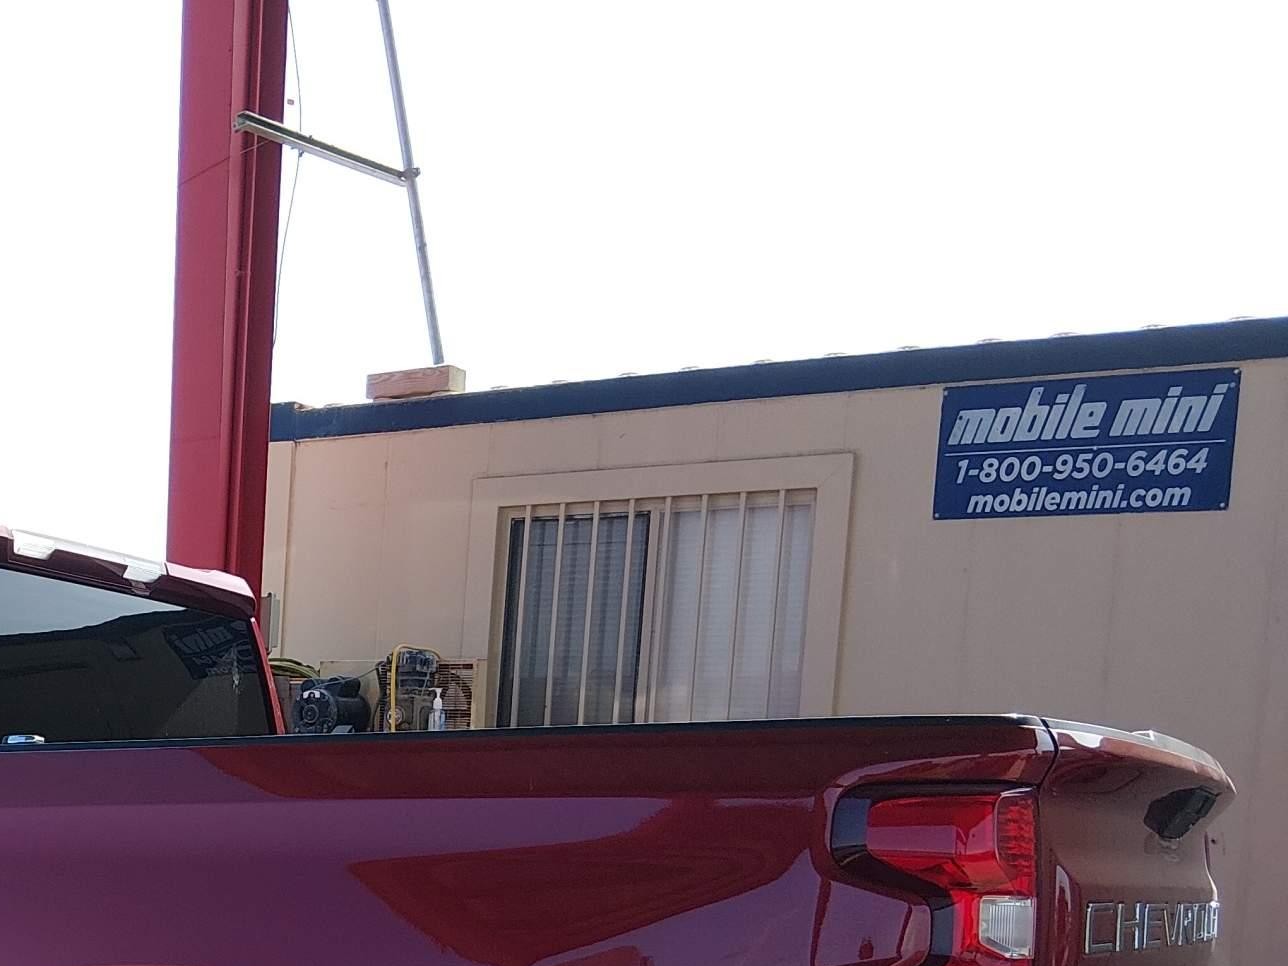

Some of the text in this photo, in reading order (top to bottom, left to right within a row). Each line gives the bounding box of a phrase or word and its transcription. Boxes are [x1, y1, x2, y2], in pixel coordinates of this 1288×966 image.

[947, 384, 1229, 445] mobile mini
[956, 448, 1210, 484] 1-800-950-6464
[966, 484, 1192, 513] mobilemini.com
